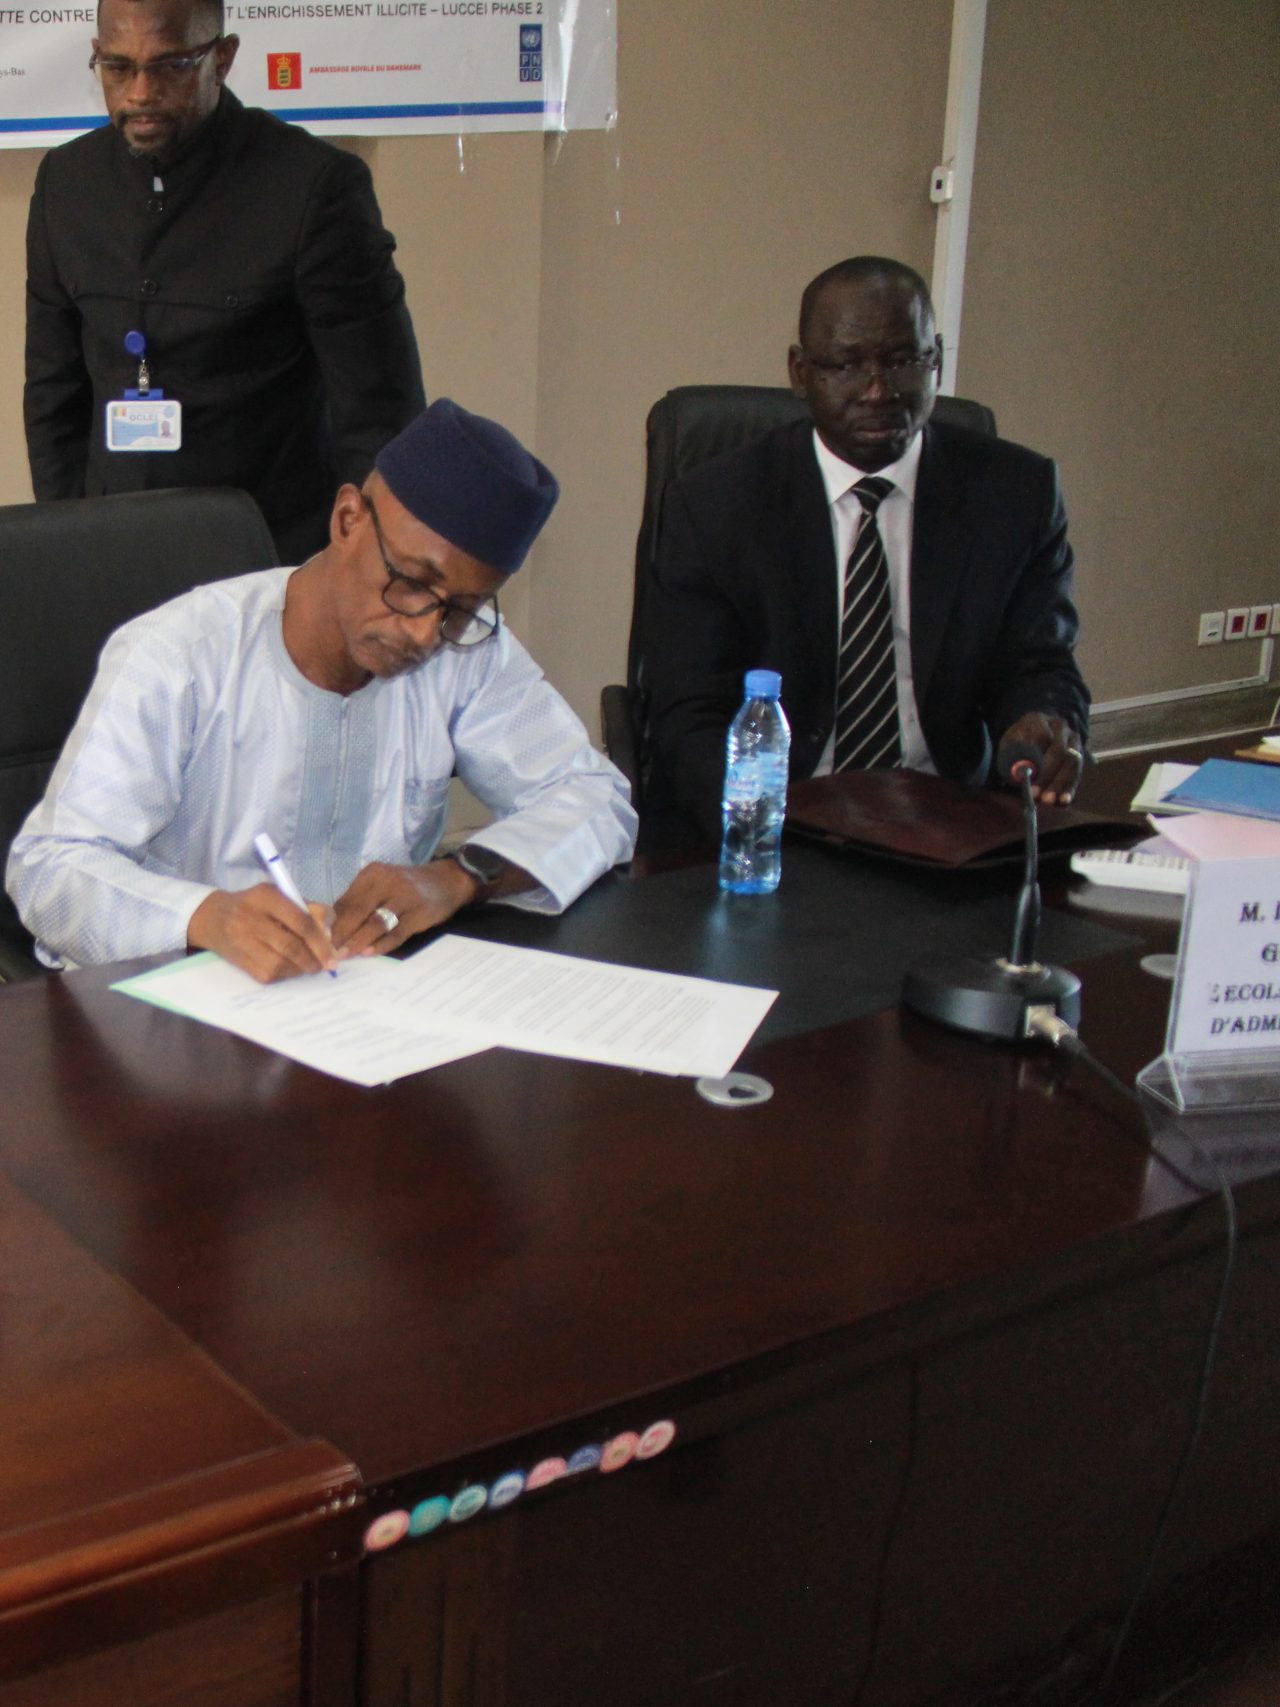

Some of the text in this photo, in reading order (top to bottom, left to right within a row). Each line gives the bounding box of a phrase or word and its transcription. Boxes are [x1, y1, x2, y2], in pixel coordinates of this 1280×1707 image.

[29, 9, 95, 23] CONTRE
[237, 4, 373, 20] L'ENRICHISSEMENT
[376, 3, 427, 17] ILLICITE
[442, 3, 488, 16] LUCCEI
[491, 2, 532, 15] PHASE
[536, 2, 543, 14] 2
[1240, 902, 1266, 922] M.
[1210, 1014, 1280, 1034] D'ADM
